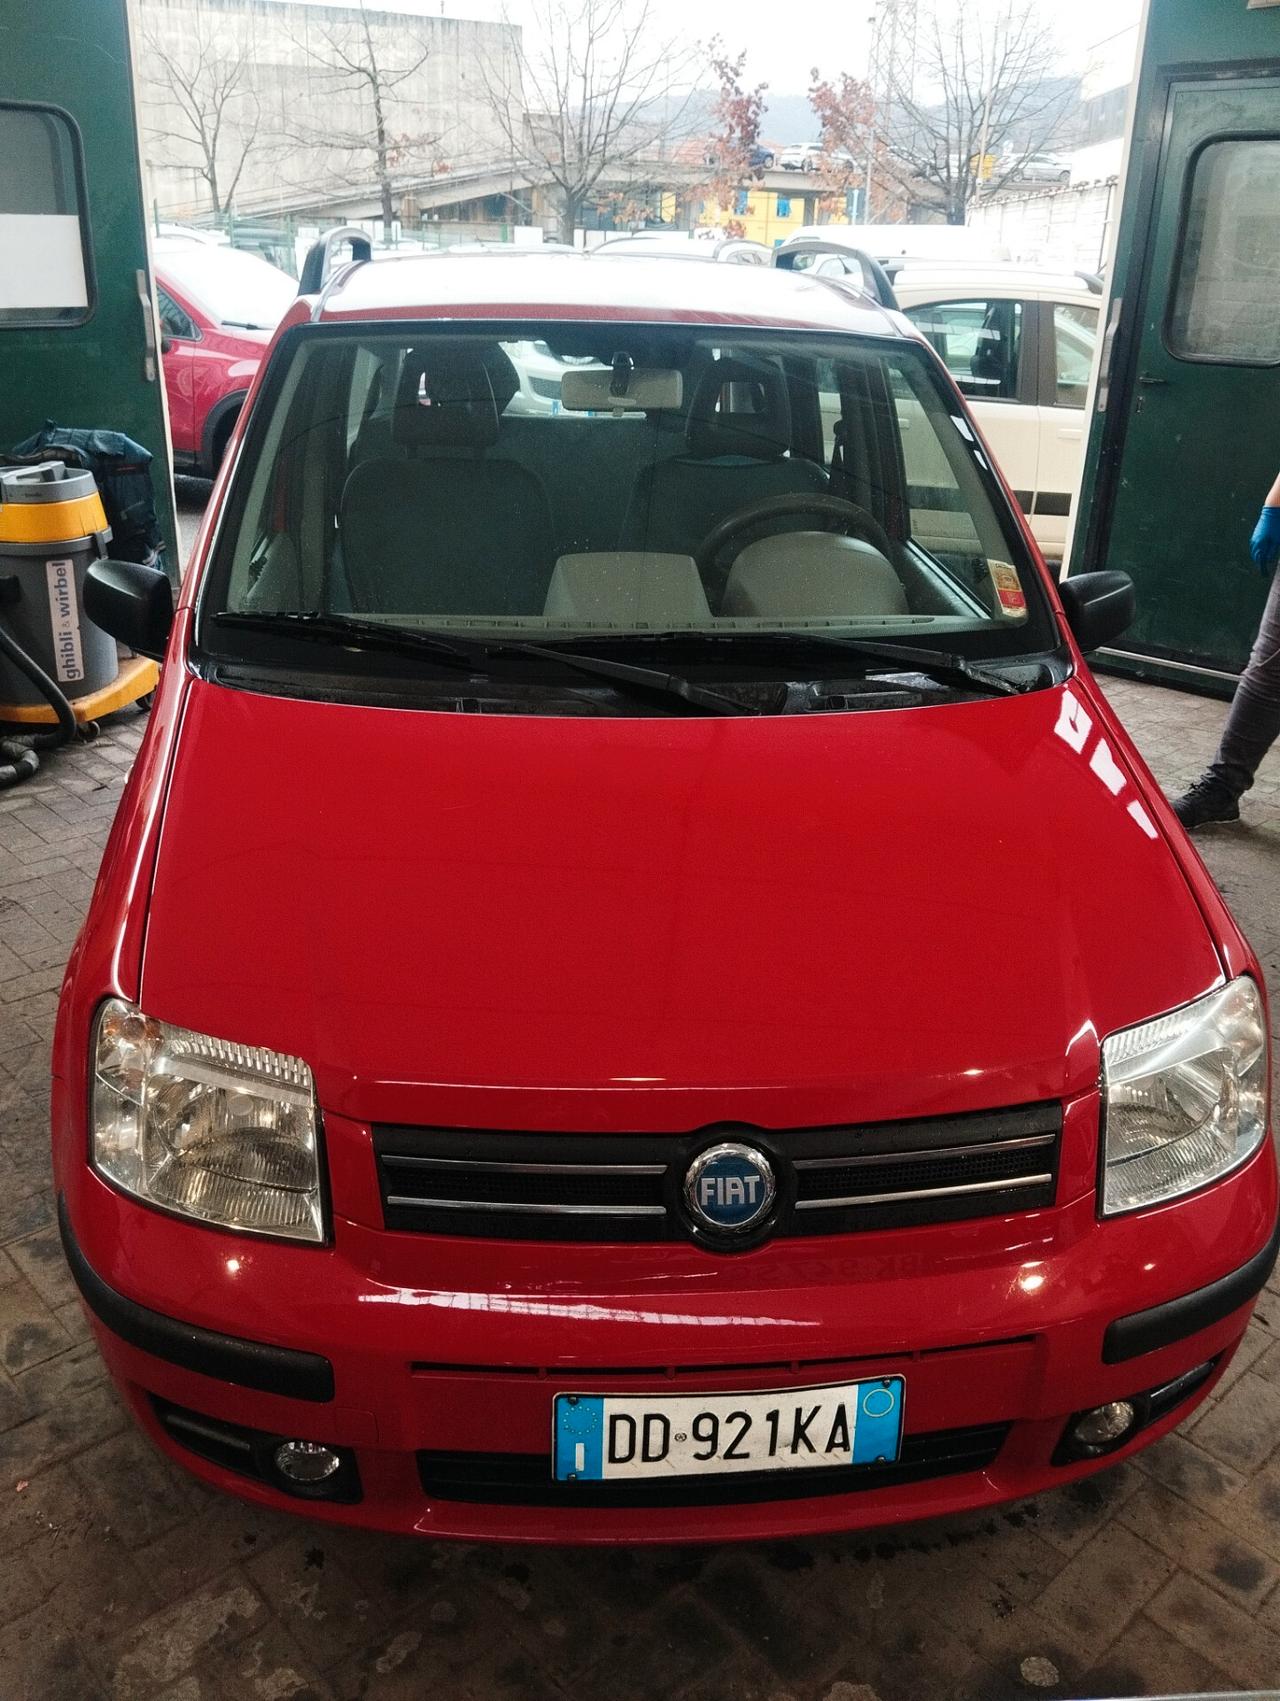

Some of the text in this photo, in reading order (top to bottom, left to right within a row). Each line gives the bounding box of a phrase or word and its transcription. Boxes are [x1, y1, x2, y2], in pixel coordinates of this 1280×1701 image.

[51, 561, 70, 618] wirbel
[59, 631, 81, 680] ghibli
[700, 1175, 761, 1206] FIAT
[575, 1443, 585, 1472] I
[607, 1403, 851, 1464] DD 921KA
